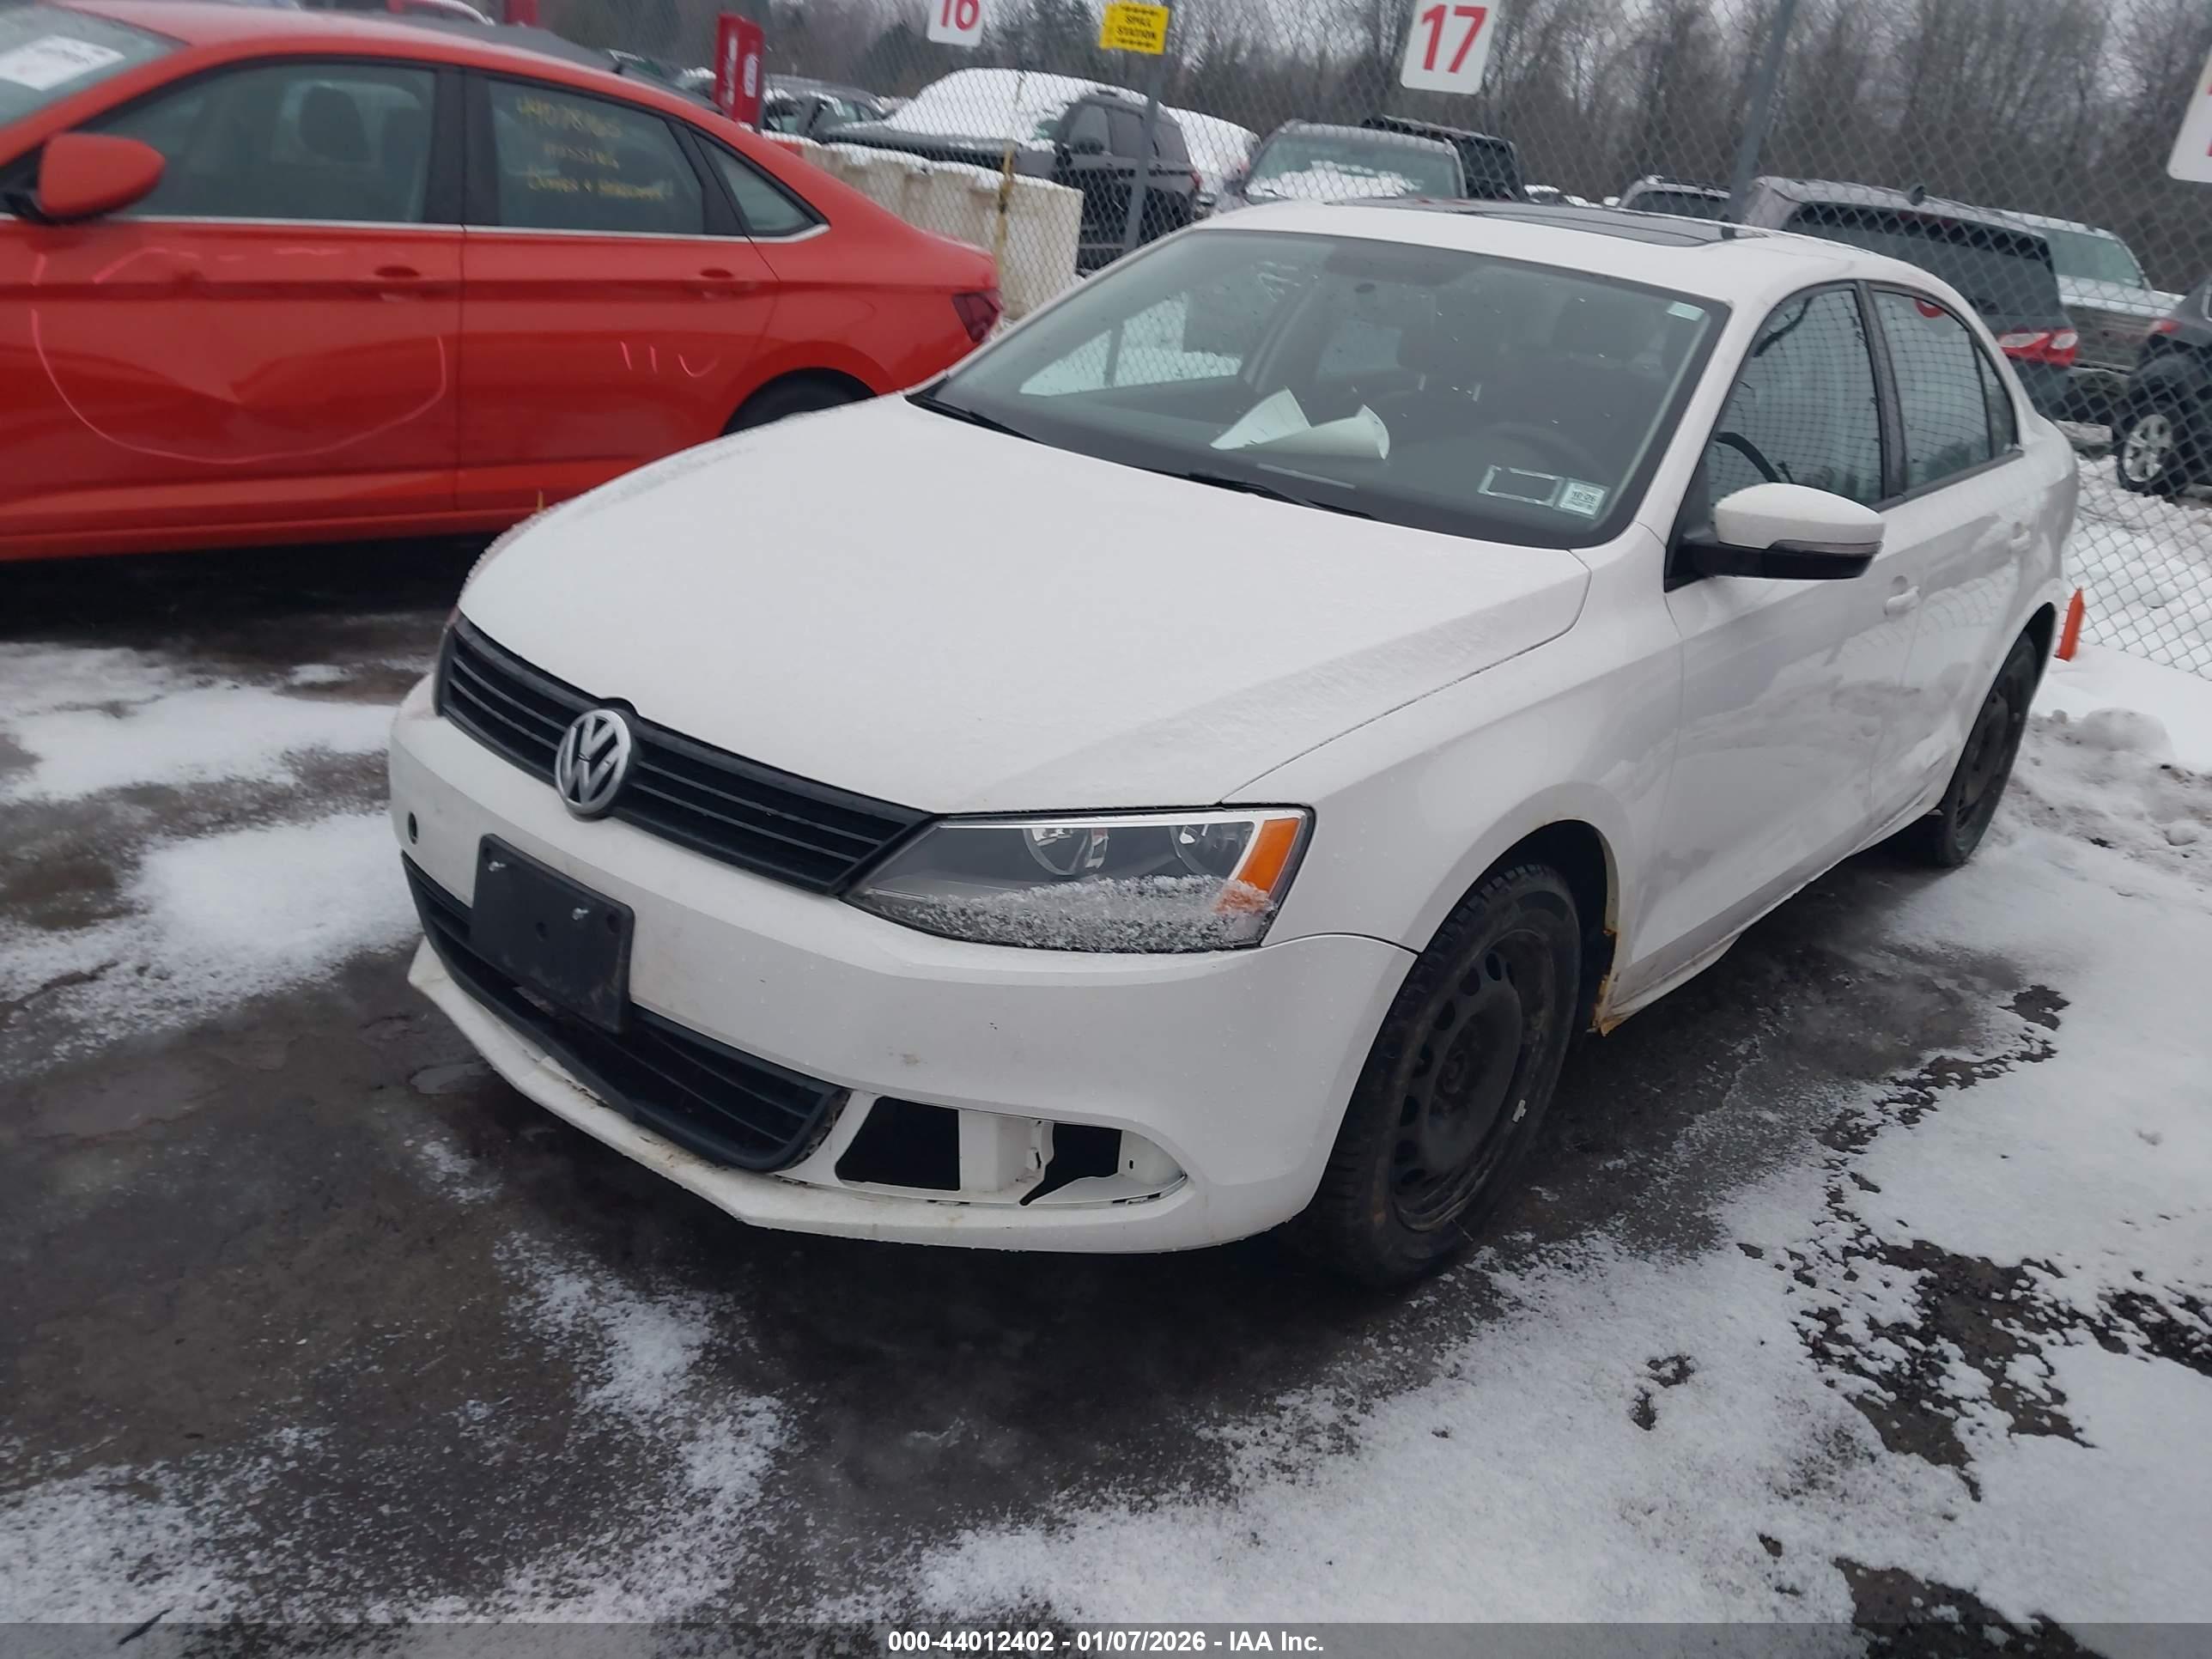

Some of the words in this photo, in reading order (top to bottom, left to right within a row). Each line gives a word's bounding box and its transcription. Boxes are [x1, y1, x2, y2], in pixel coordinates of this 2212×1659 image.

[1116, 26, 1157, 40] STATION
[1126, 15, 1152, 28] SPILL
[1422, 4, 1486, 72] 17
[556, 708, 631, 813] VW
